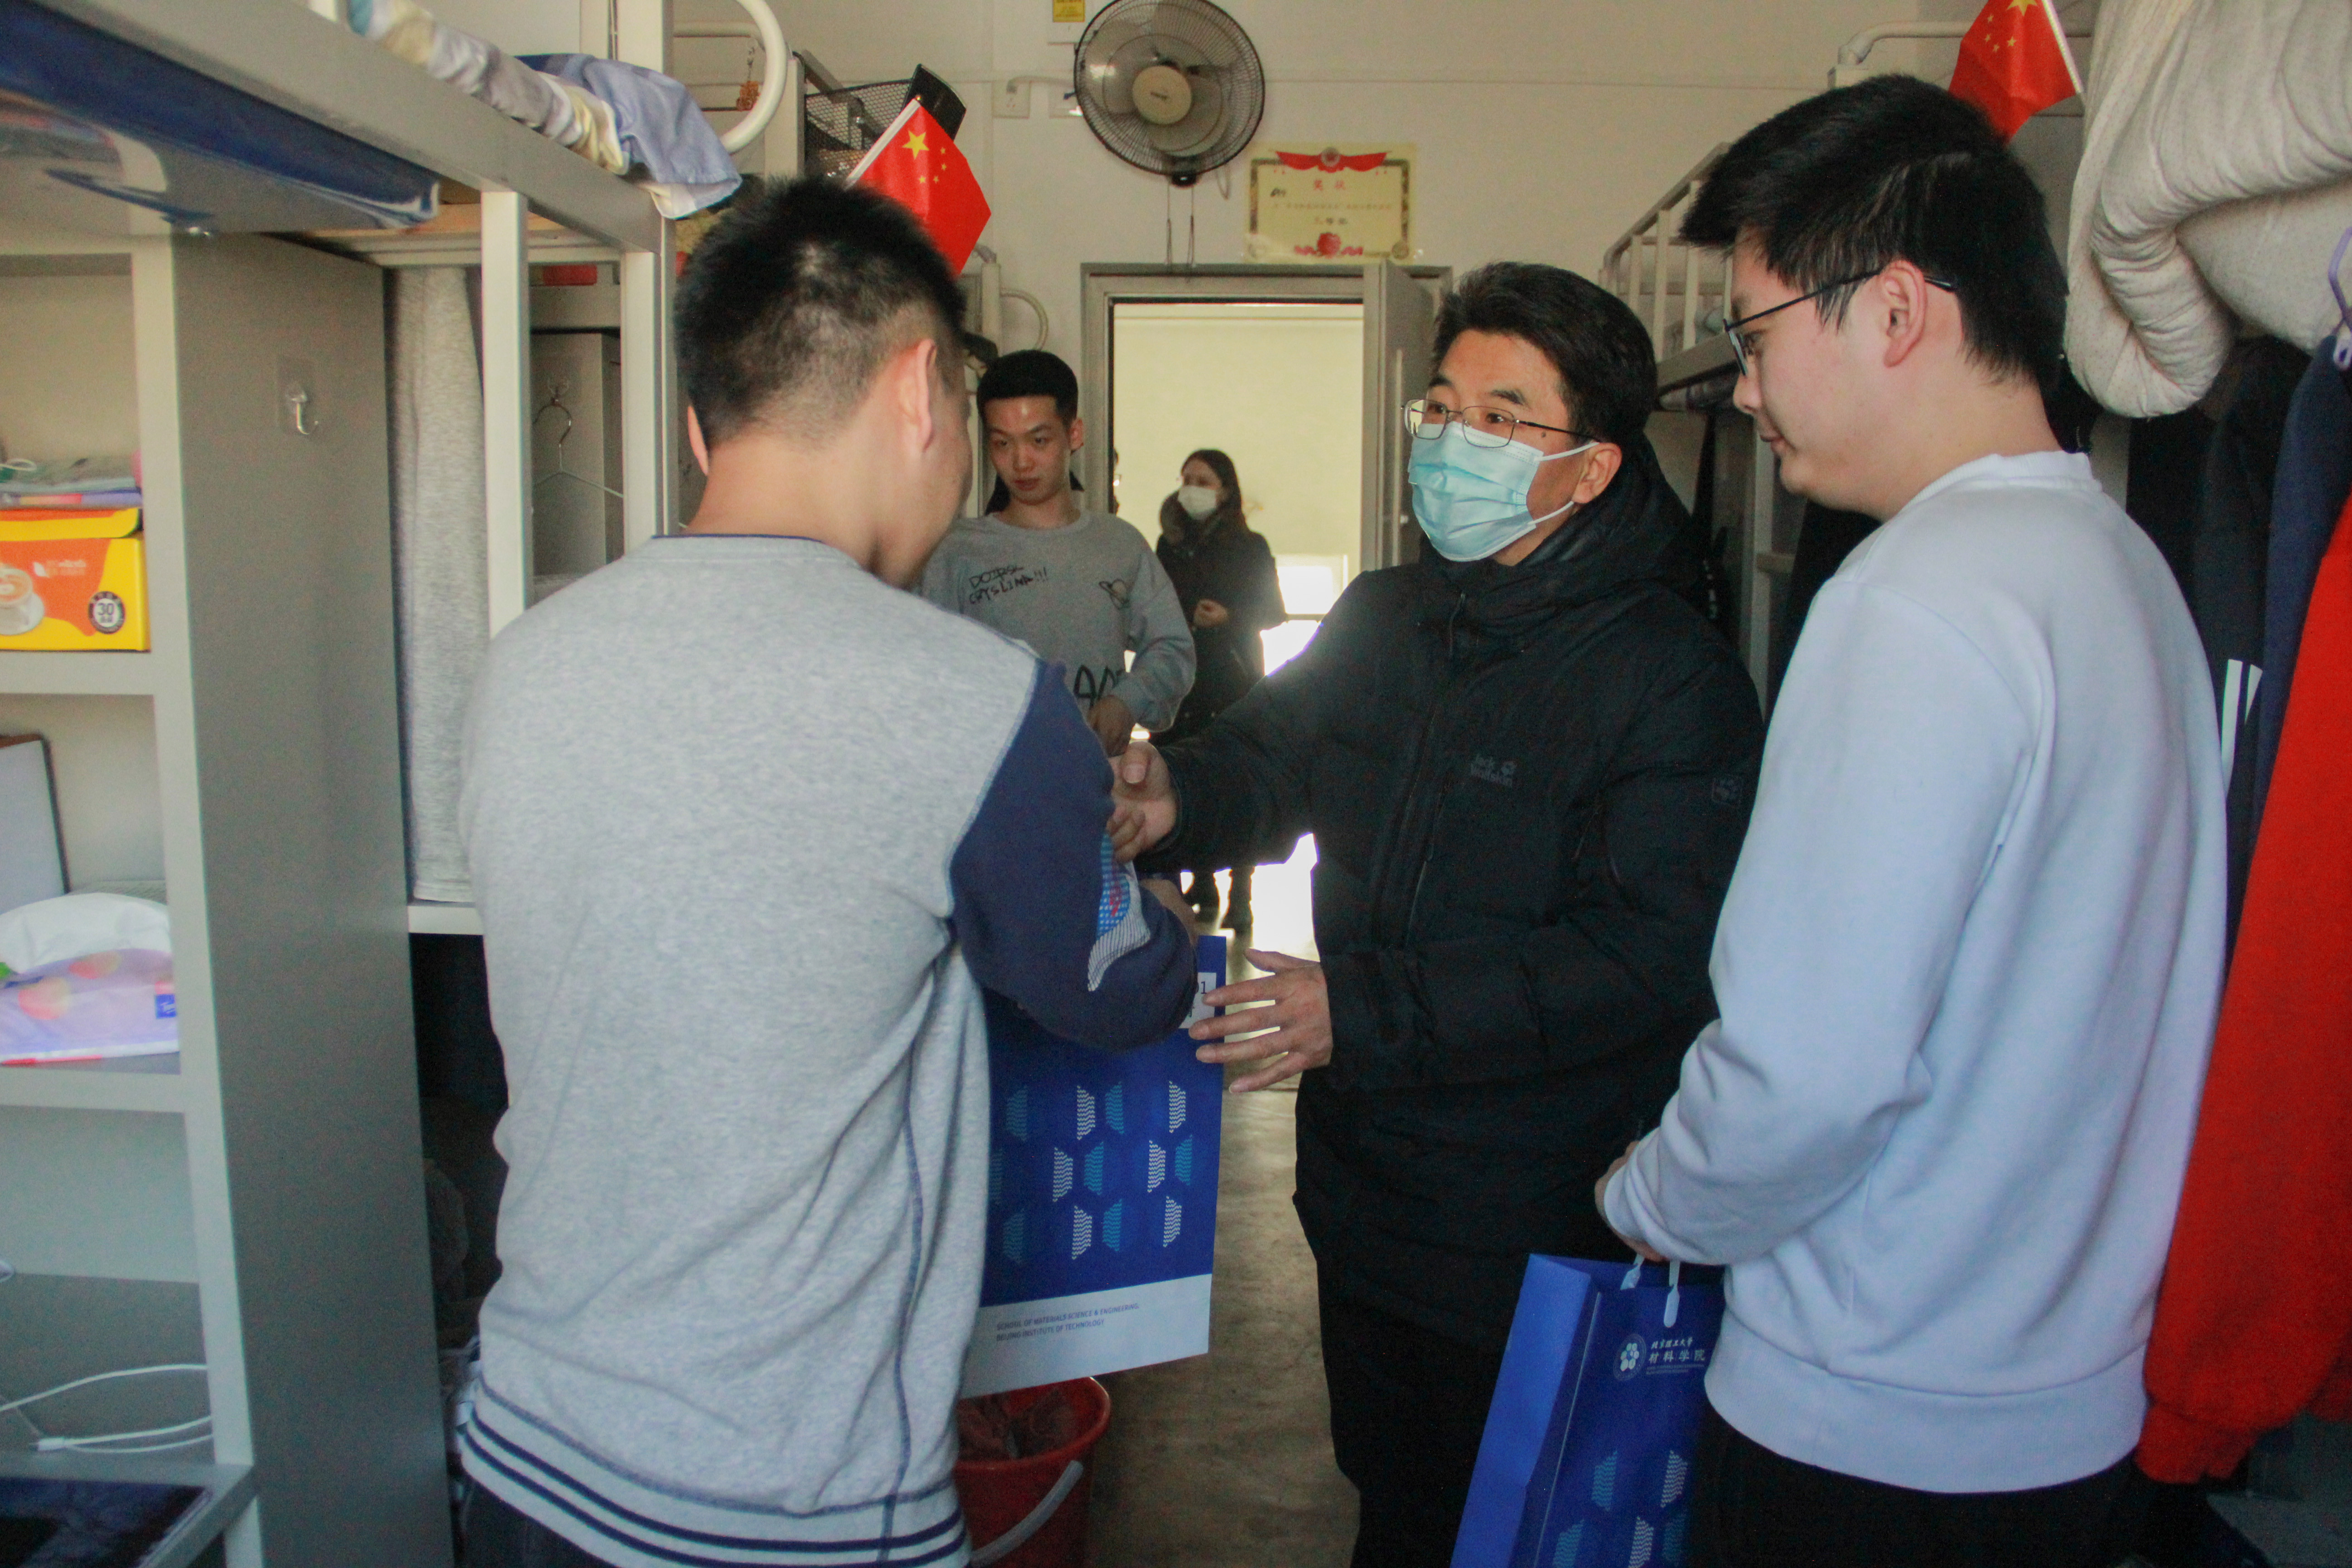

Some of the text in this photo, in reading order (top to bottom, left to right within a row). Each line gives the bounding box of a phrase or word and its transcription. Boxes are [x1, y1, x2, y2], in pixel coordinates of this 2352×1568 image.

[98, 603, 114, 615] 30
[997, 1321, 1021, 1331] SCHOOL
[1034, 1314, 1066, 1324] MATERIALS
[1068, 1310, 1093, 1319] SCIENCE
[997, 1331, 1021, 1342] BEIJING
[1023, 1327, 1054, 1337] INSTITUTE
[1065, 1319, 1104, 1330] TECHNOLOGY
